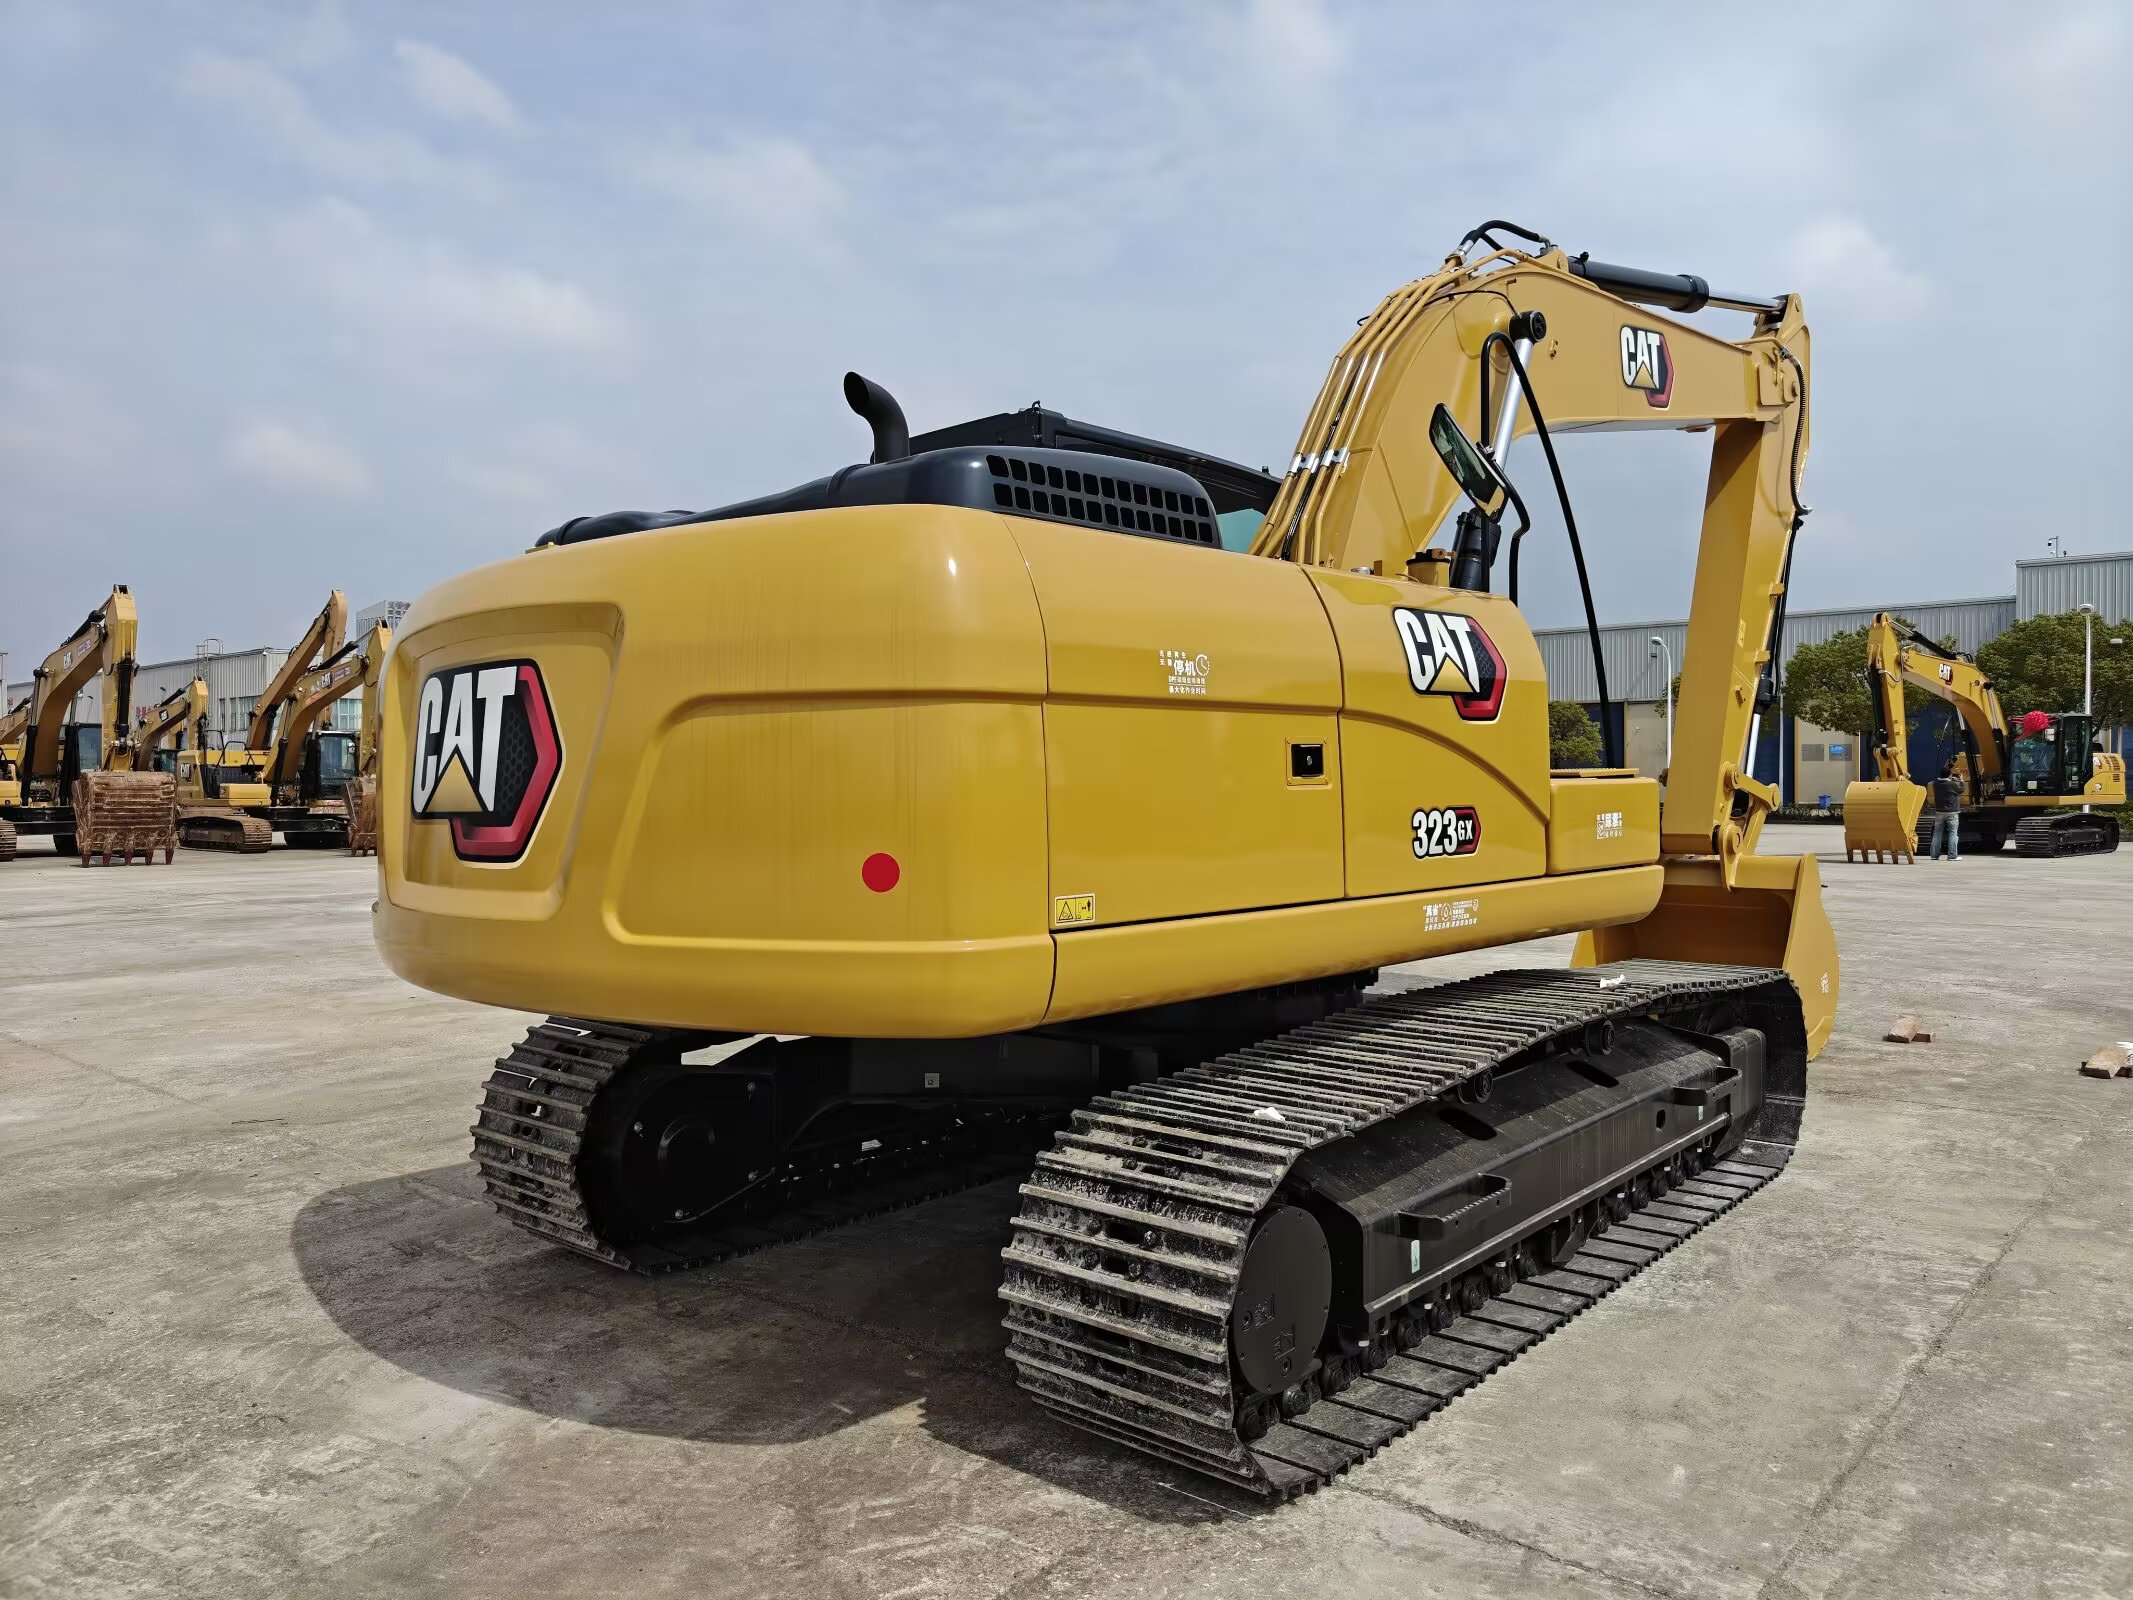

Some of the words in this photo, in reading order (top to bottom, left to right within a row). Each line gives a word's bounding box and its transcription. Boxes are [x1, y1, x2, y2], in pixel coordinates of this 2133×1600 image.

[1621, 326, 1660, 389] CAT
[1394, 608, 1480, 693] CAT
[413, 665, 518, 813] CAT
